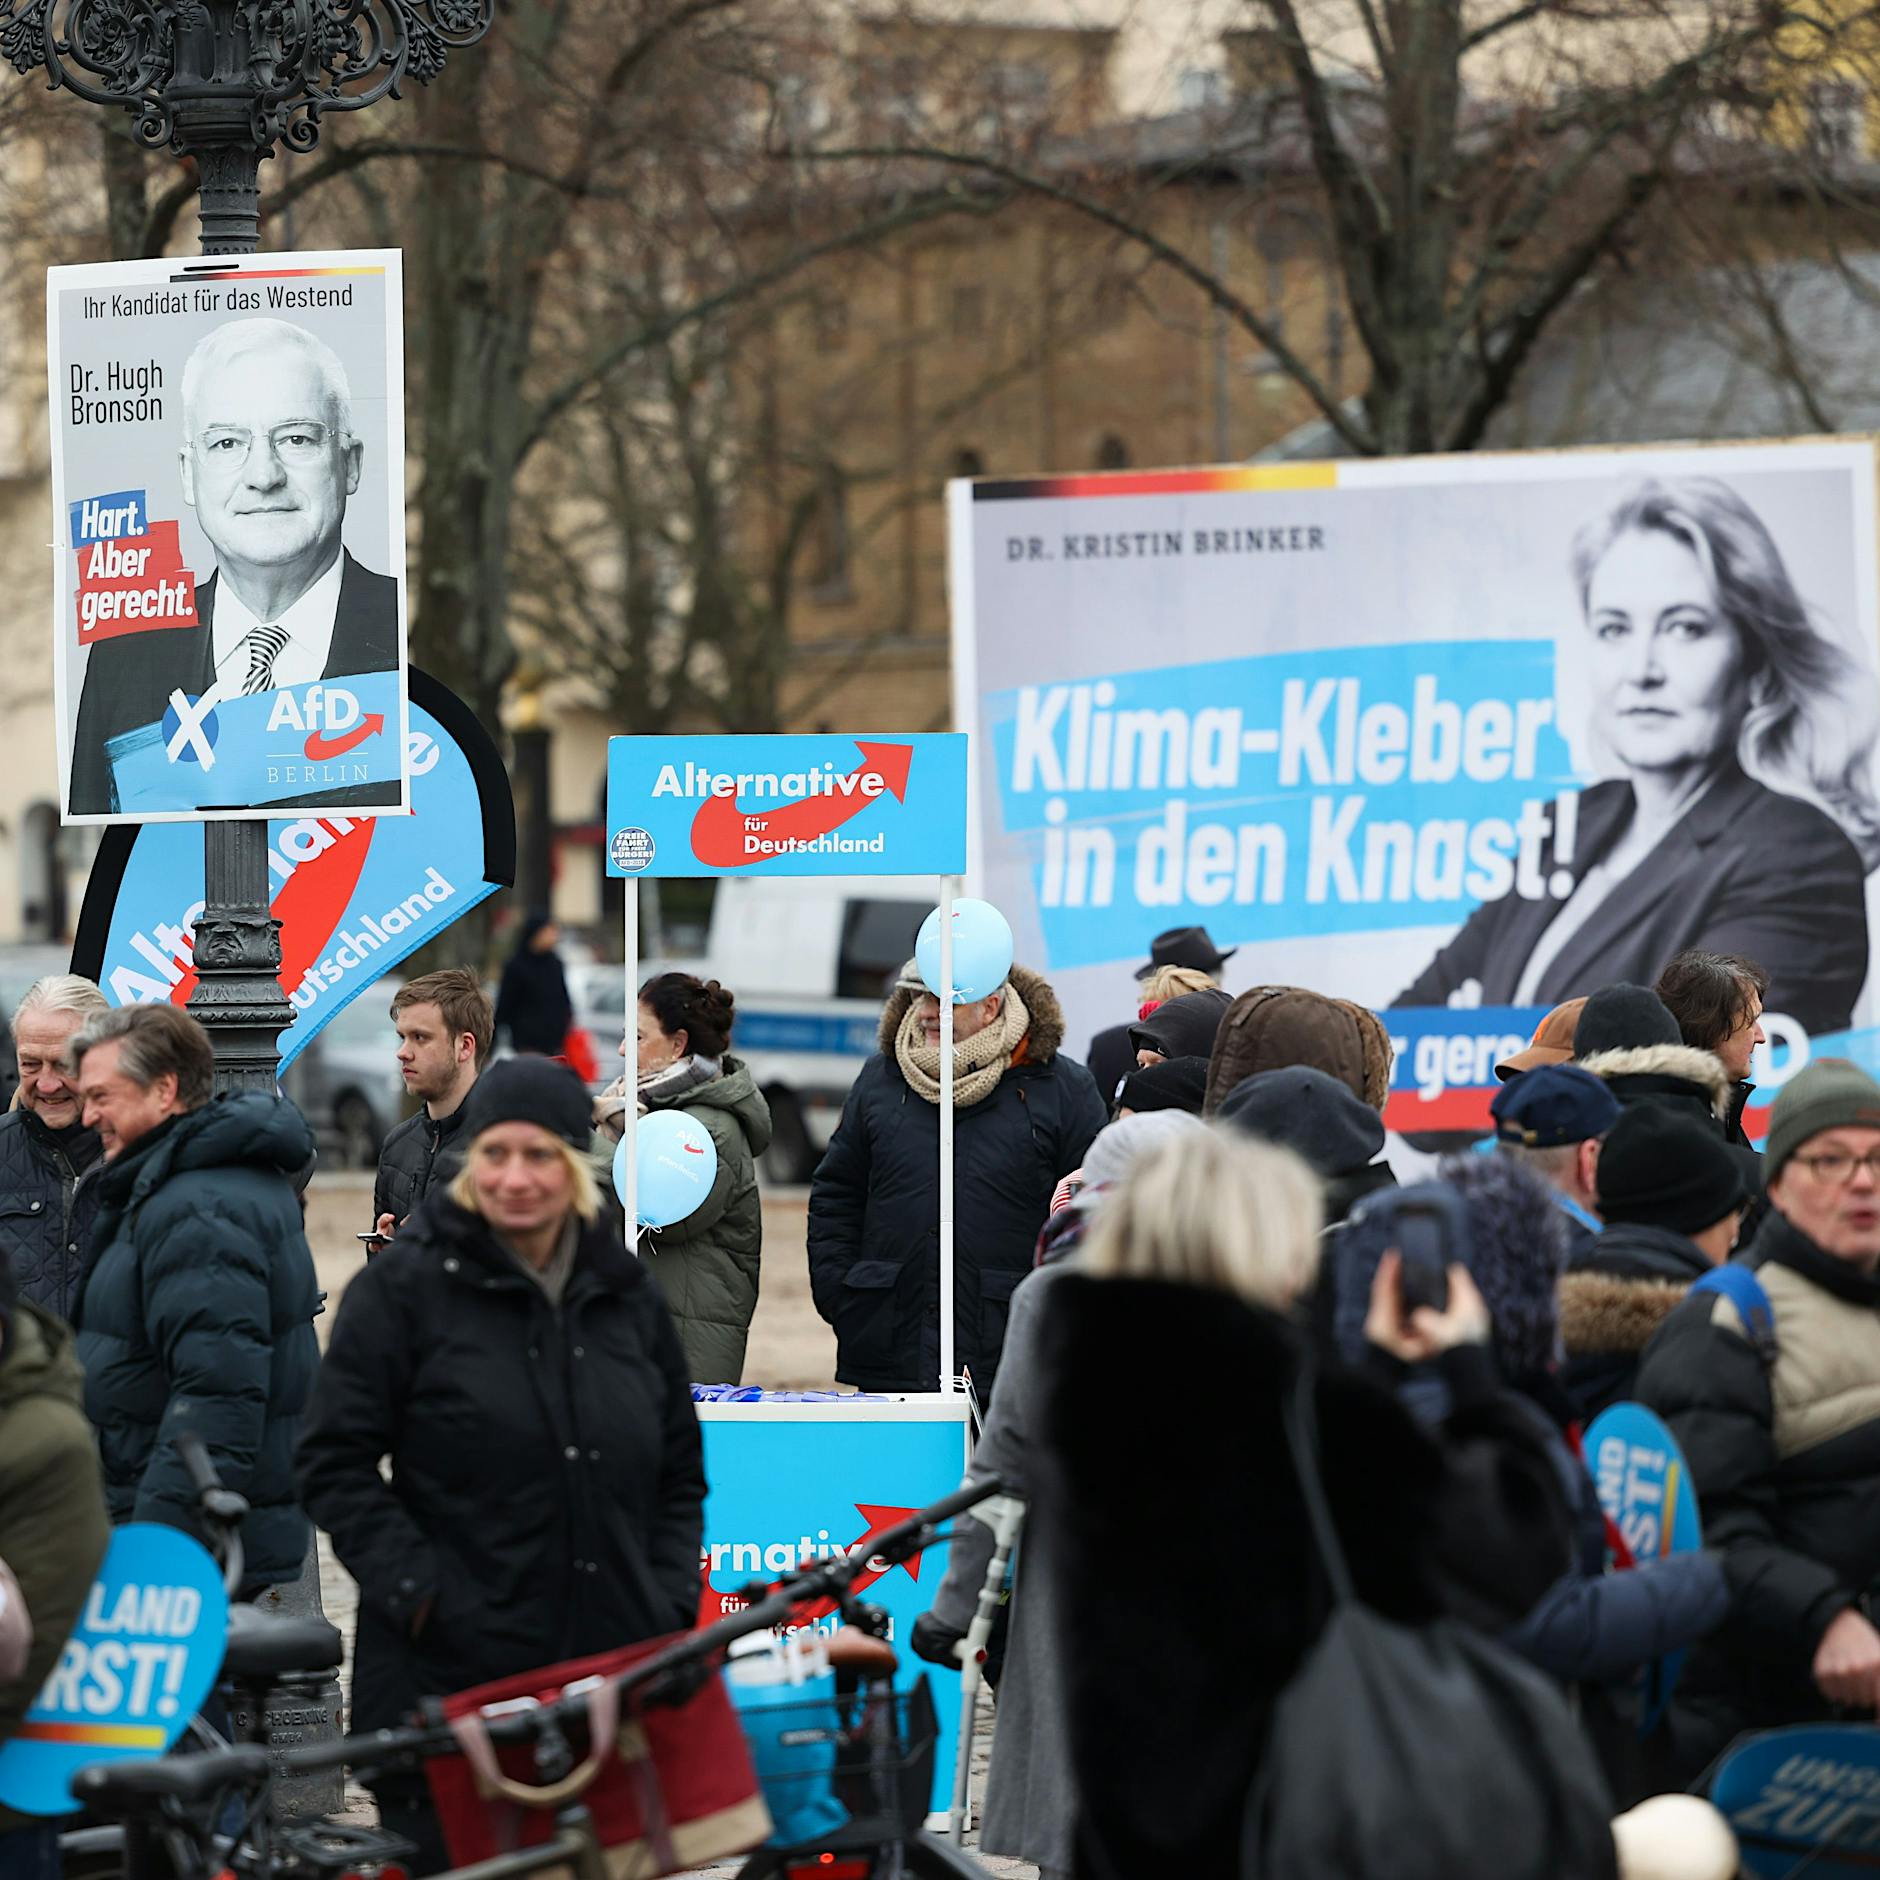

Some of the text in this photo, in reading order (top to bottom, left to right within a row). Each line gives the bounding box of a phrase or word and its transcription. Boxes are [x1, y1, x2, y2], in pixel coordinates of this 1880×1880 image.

[84, 284, 352, 319] Ihr Kandidat für das Westend
[70, 359, 163, 397] Dr. Hugh
[71, 394, 163, 426] Bronson
[80, 500, 145, 539] Hart.
[86, 541, 152, 580] Aber
[1006, 526, 1324, 561] DR. KRISTIN BRINKER
[81, 579, 193, 631] gerecht.
[266, 685, 360, 732] AfD
[1012, 675, 1554, 792] Klima-Kleber
[267, 764, 369, 784] BERLIN
[651, 762, 885, 798] Alternative
[744, 816, 768, 832] für
[744, 832, 884, 854] Deutschland
[1041, 790, 1579, 908] in den Knast!
[288, 866, 456, 1011] utschland
[84, 1580, 202, 1638] LAND
[720, 1596, 751, 1614] für
[38, 1638, 189, 1718] RST!
